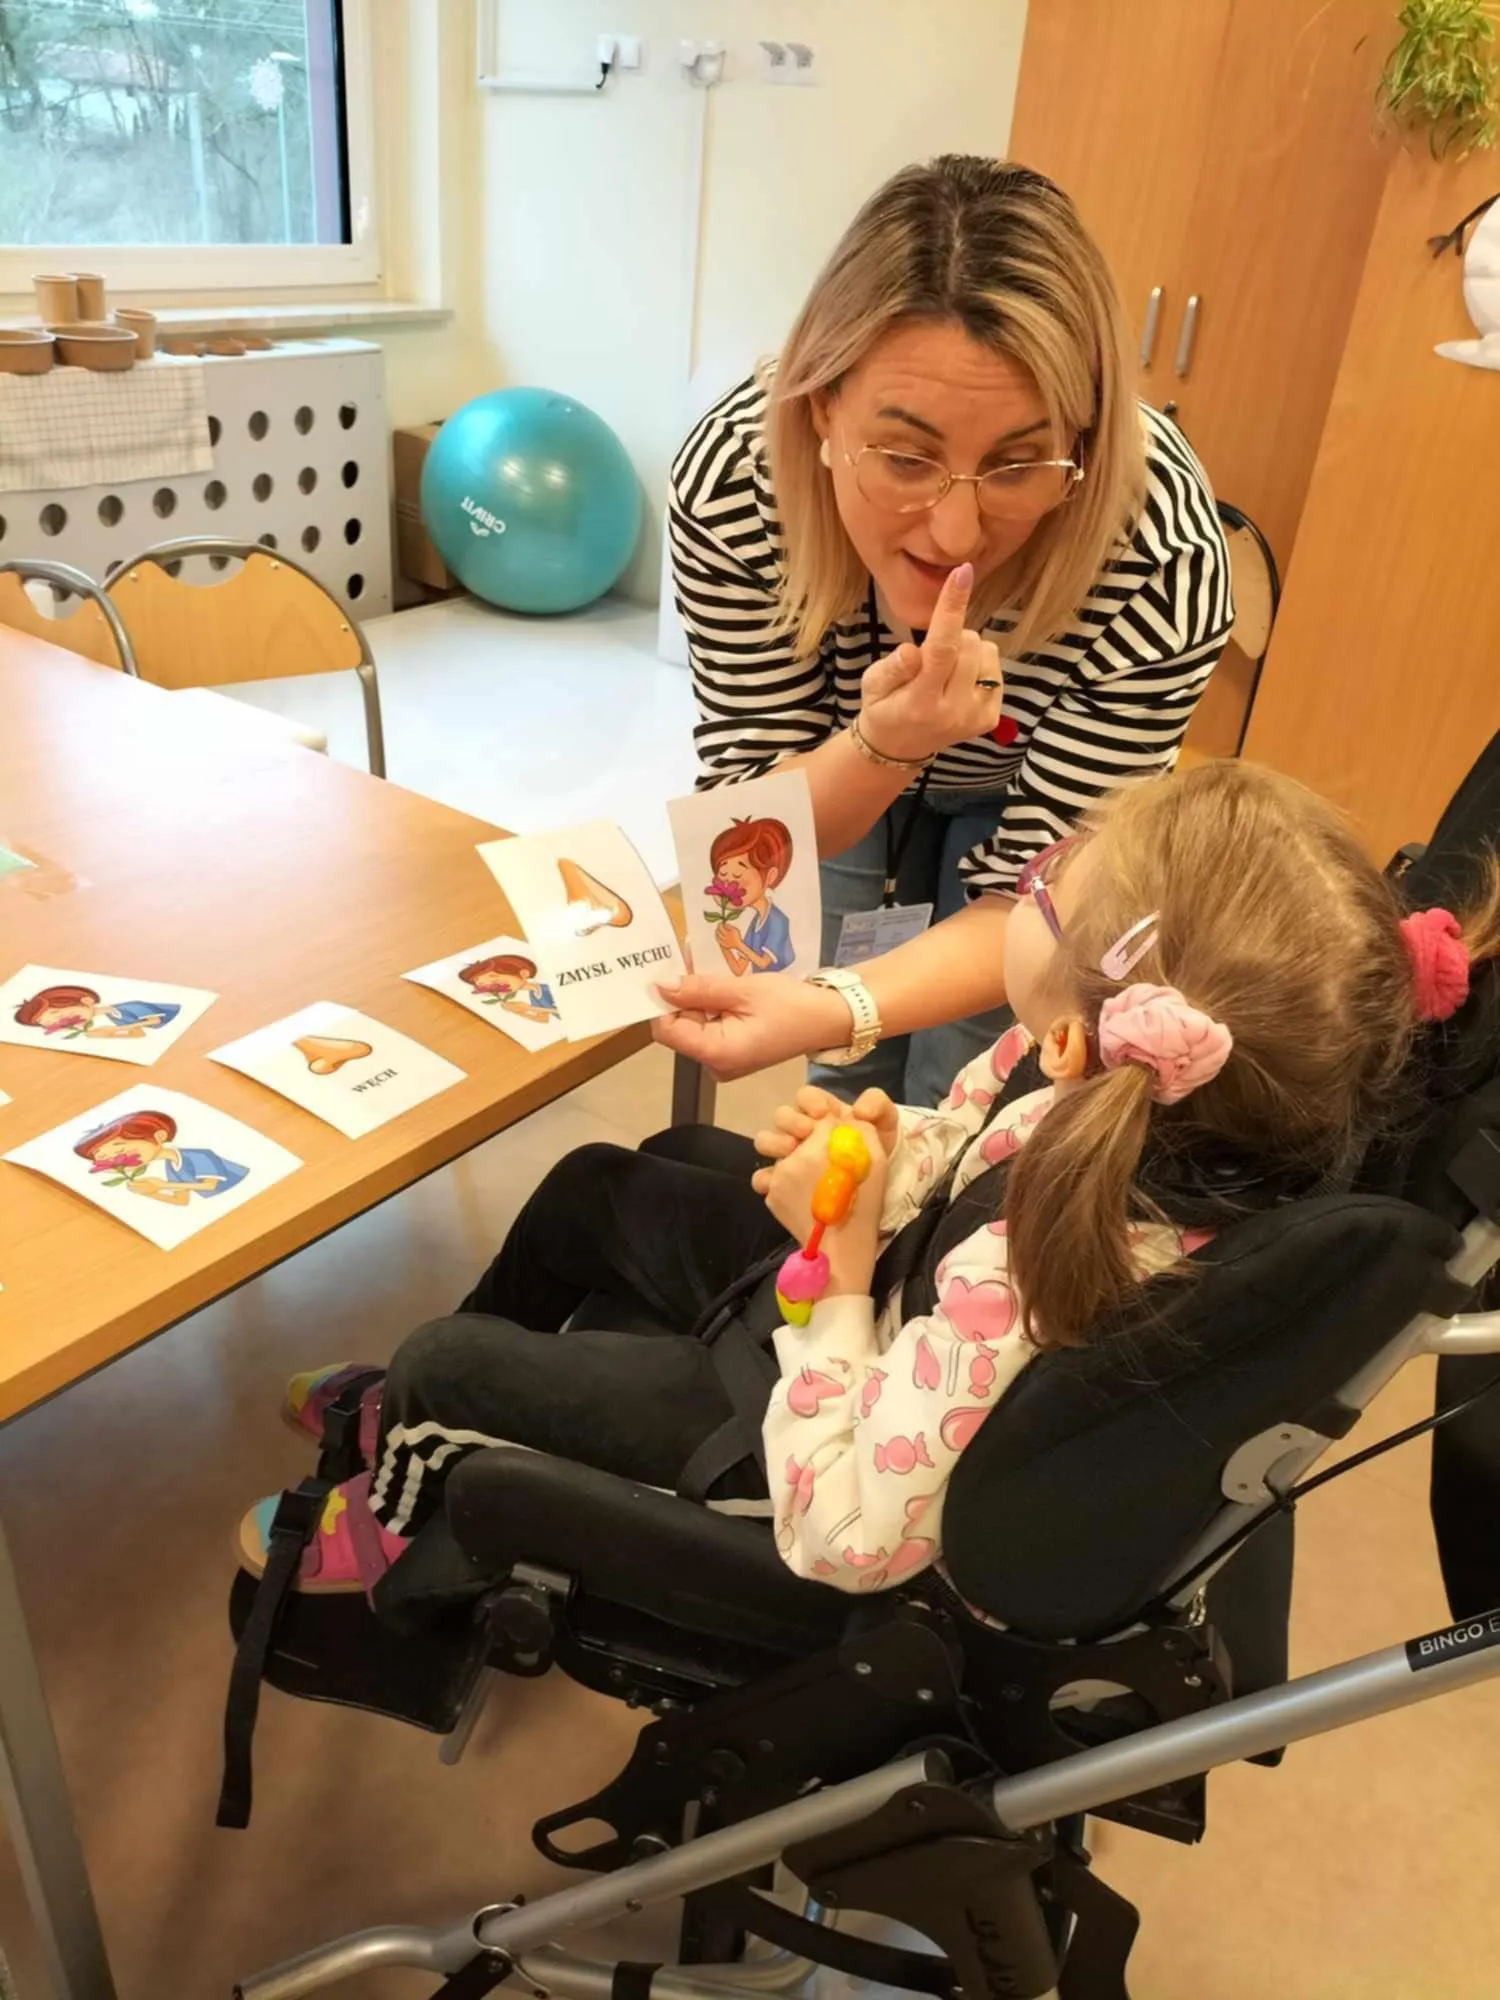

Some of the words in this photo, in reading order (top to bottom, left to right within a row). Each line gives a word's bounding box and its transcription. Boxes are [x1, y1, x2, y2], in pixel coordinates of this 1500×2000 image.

[616, 944, 672, 969] WĘCHU
[351, 1068, 398, 1093] WĘCH
[1419, 1623, 1484, 1656] BINGO
